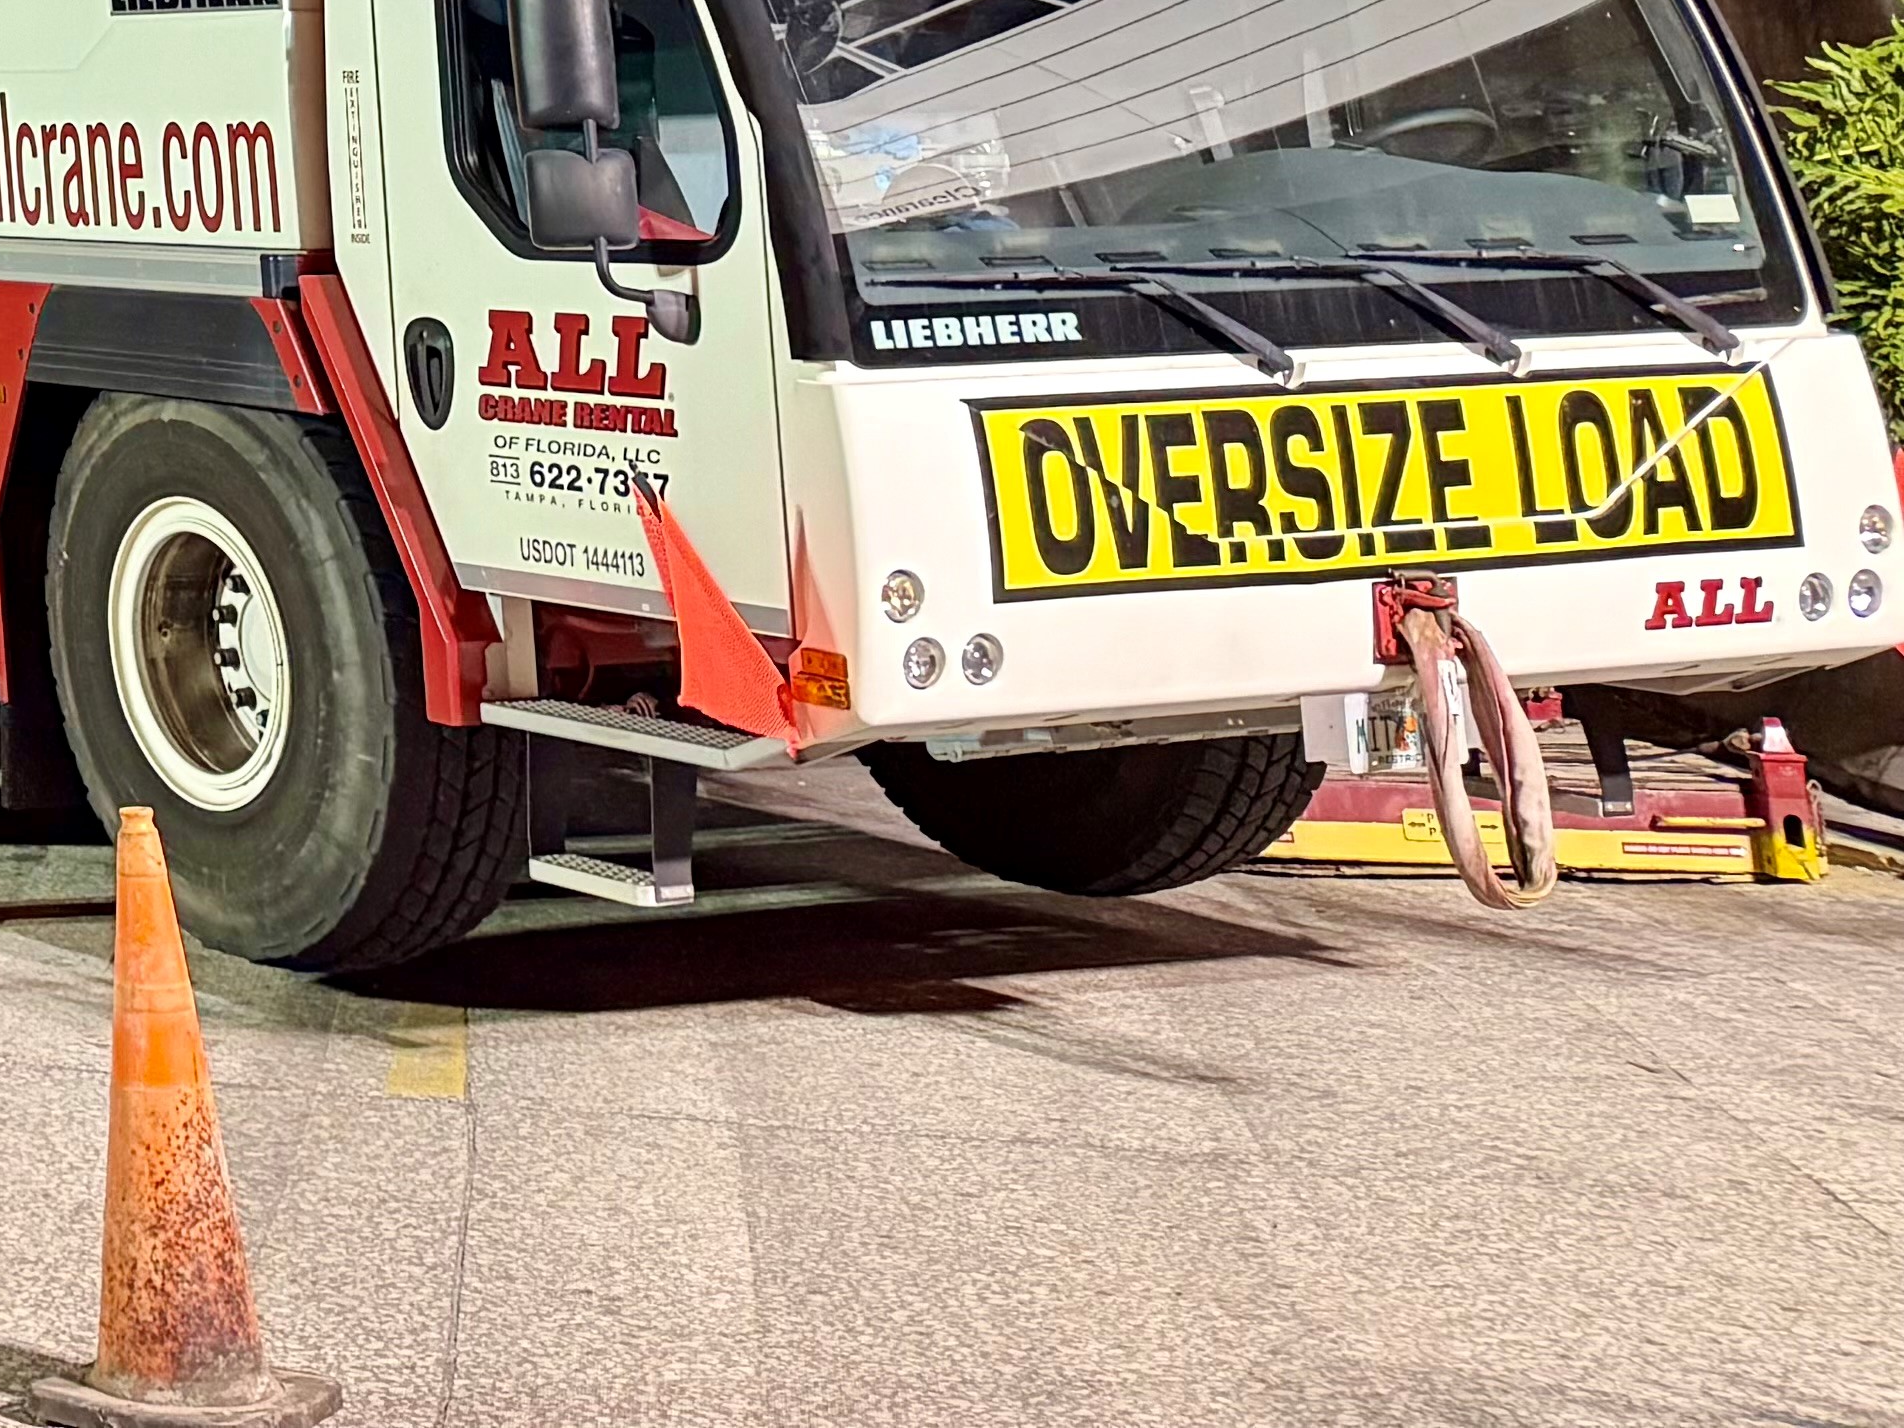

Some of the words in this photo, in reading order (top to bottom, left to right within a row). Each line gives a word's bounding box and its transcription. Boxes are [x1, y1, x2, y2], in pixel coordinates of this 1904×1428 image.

[341, 69, 360, 84] FIRE
[869, 311, 1083, 350] LIEBHERR
[478, 309, 668, 401] ALL
[478, 393, 568, 428] CRANE
[573, 401, 679, 438] RENTAL
[493, 434, 520, 450] OF
[524, 437, 616, 463] FLORIDA,
[623, 446, 662, 465] LLC
[490, 460, 521, 481] 813
[1020, 399, 1493, 576] OVERSIZE
[1505, 384, 1762, 542] LOAD
[504, 490, 566, 509] TAMPA,
[578, 498, 646, 517] FLORI
[520, 536, 577, 568] USDOT
[582, 545, 646, 578] 1444113
[1644, 575, 1775, 630] ALL
